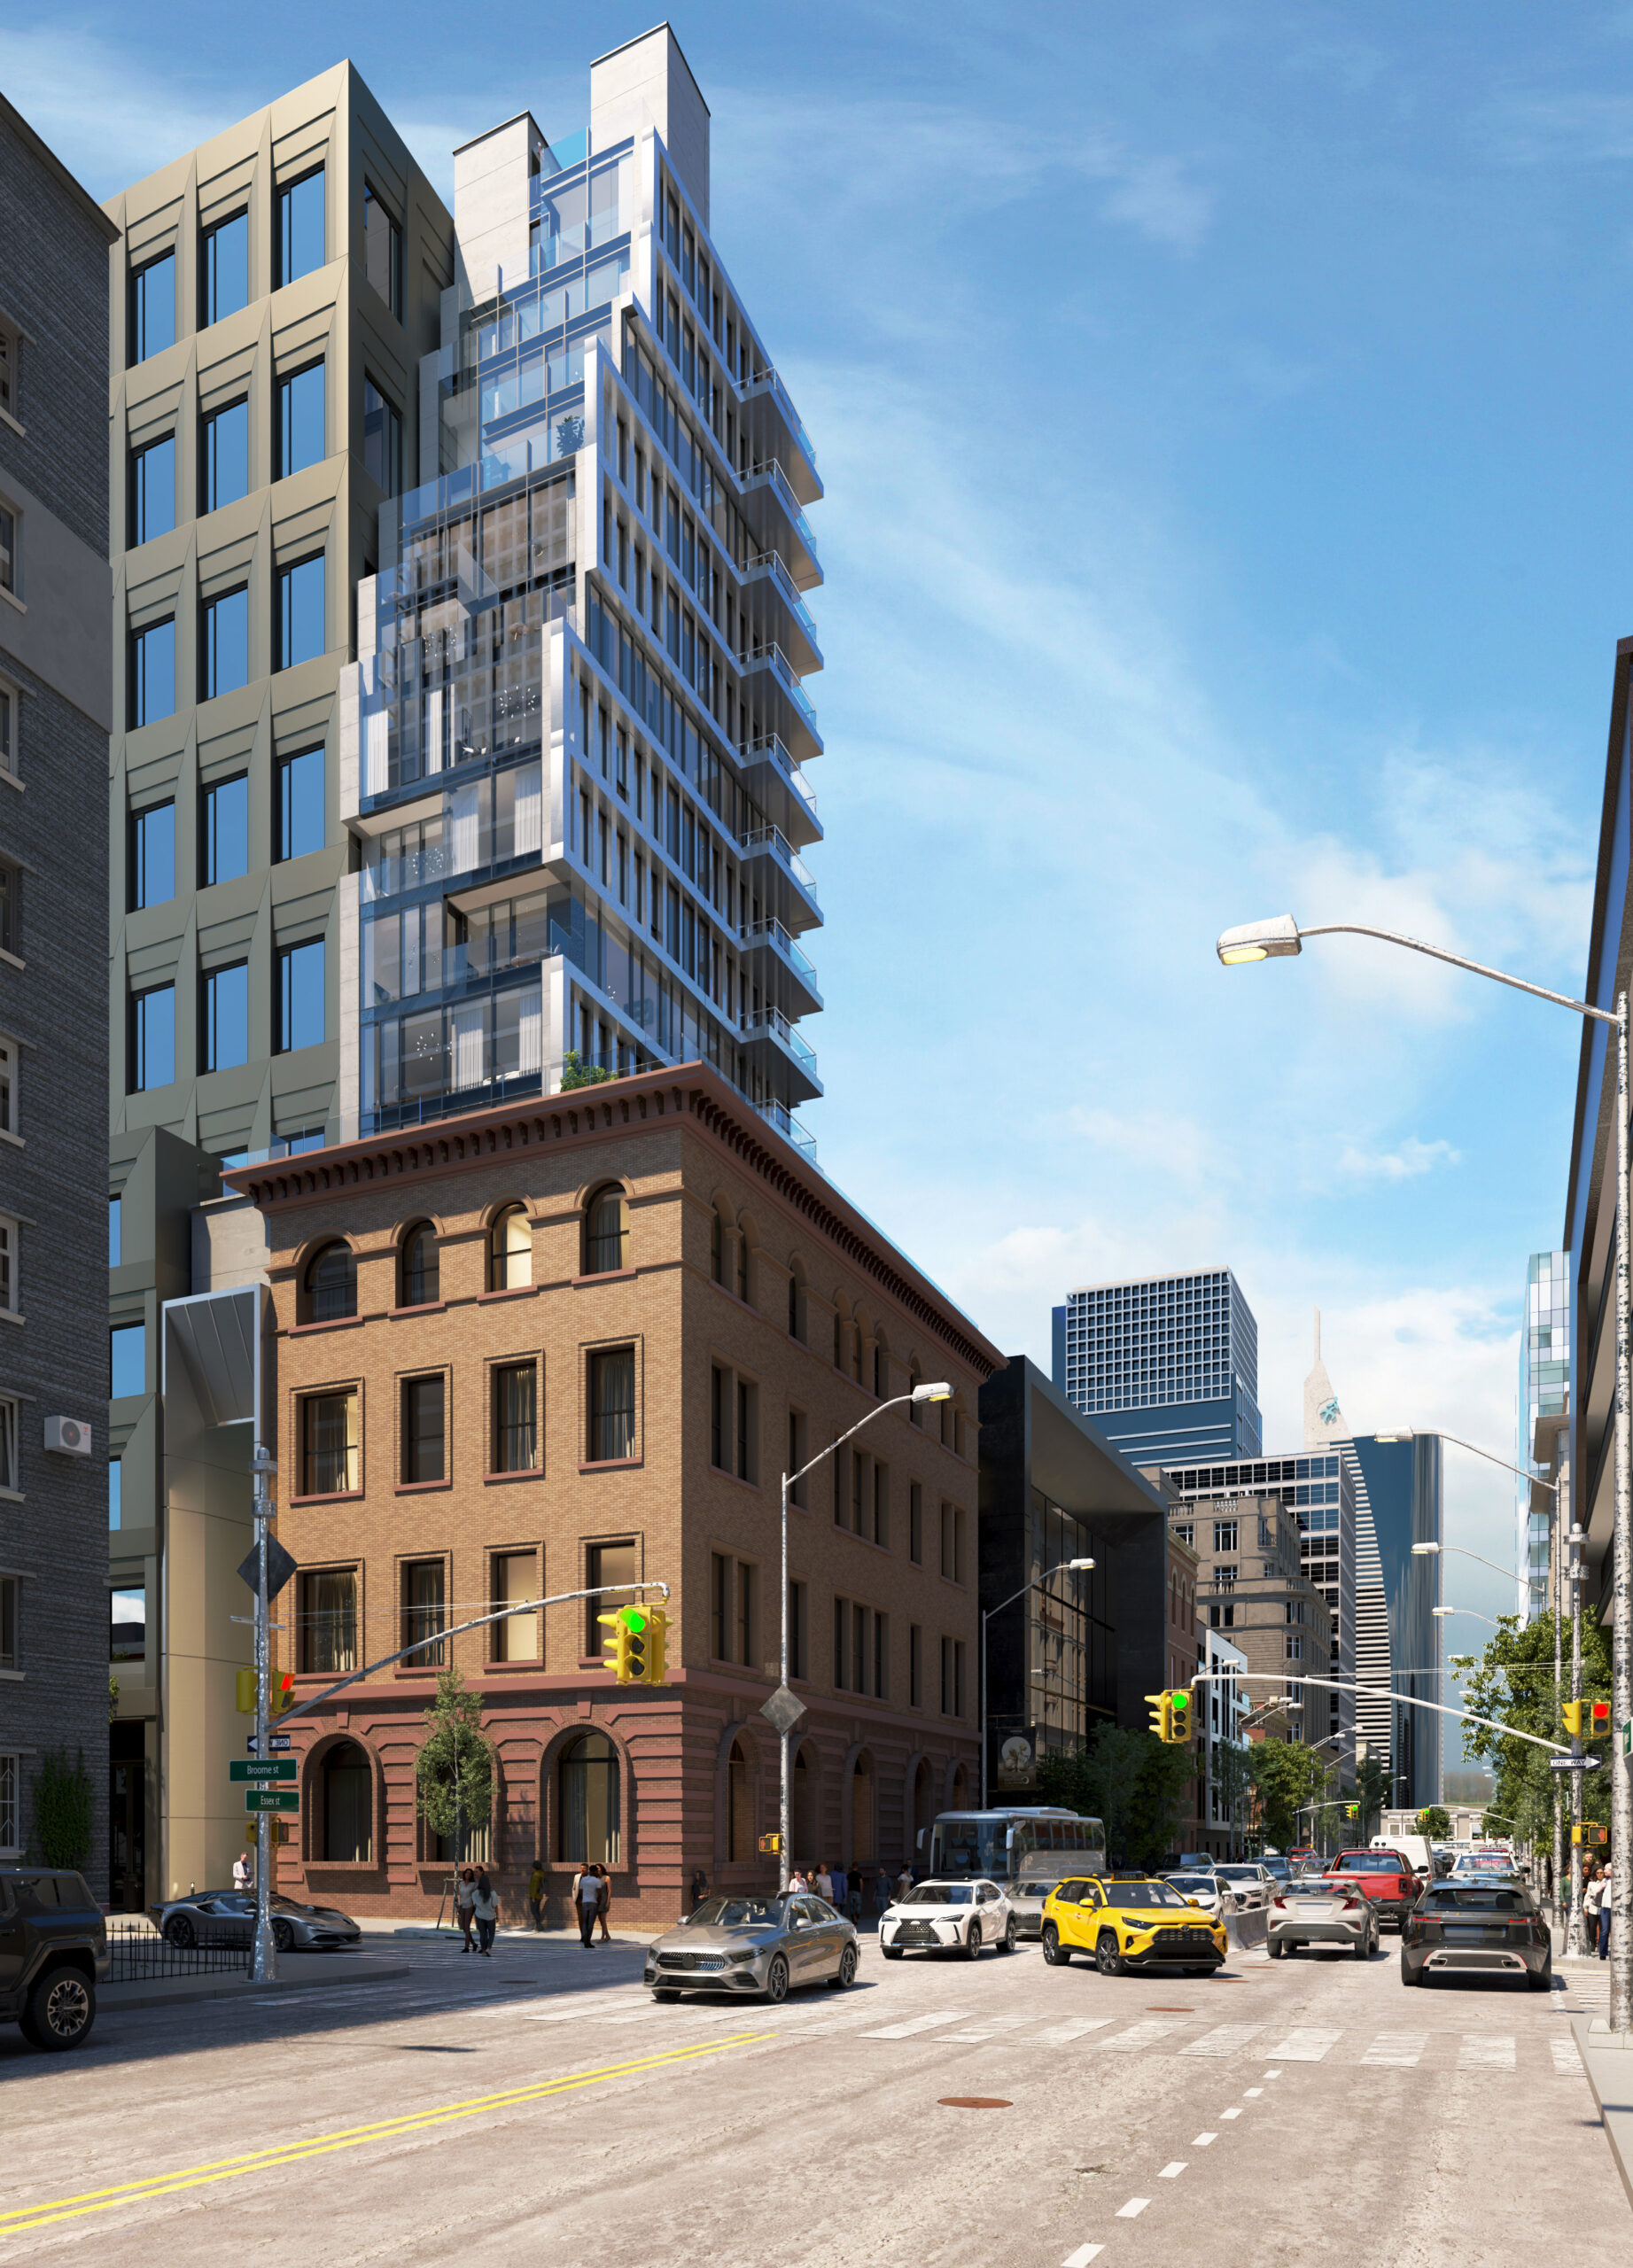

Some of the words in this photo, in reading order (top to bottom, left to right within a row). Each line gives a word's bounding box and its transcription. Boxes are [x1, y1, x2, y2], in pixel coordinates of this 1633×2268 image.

[247, 1765, 272, 1775] Broome
[261, 1795, 275, 1806] Essex
[276, 1797, 280, 1806] st
